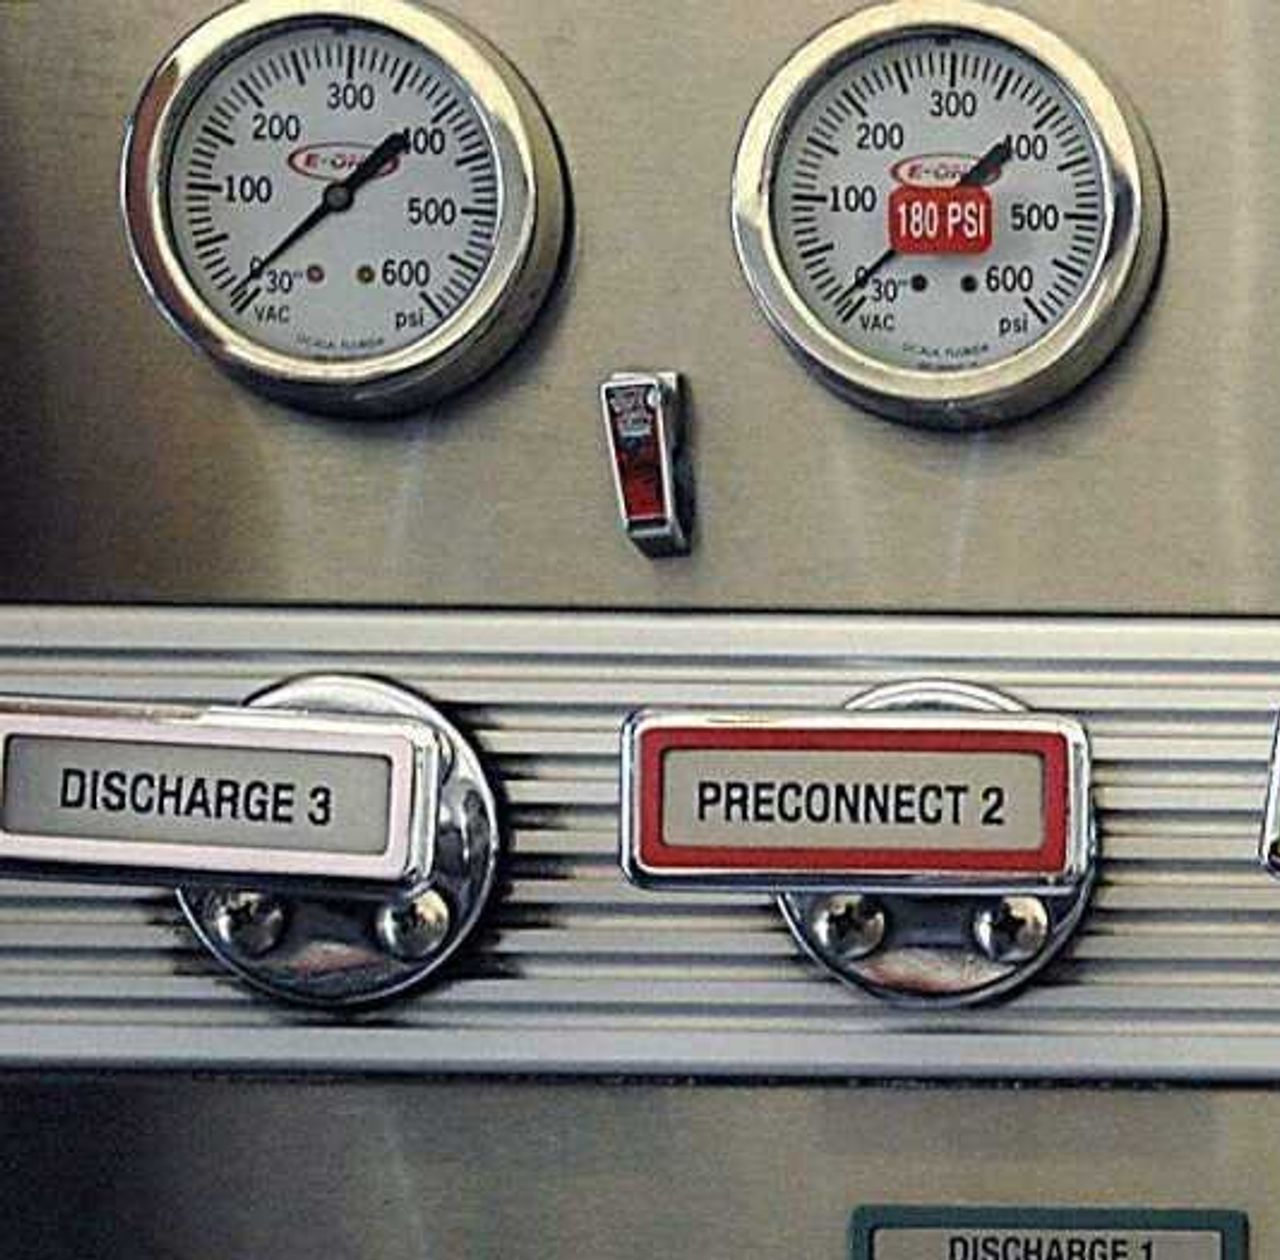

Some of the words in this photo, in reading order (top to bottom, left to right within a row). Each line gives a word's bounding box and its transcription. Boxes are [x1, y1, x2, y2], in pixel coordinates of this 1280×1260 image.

[328, 85, 374, 110] 300
[930, 91, 976, 117] 300
[253, 114, 300, 140] 200
[857, 124, 903, 149] 200
[304, 153, 365, 168] E-ON
[908, 163, 970, 179] E-ON
[226, 176, 272, 202] 100
[831, 186, 876, 212] 100
[408, 199, 456, 225] 500
[899, 202, 938, 237] 180
[949, 203, 984, 238] PSI
[1012, 205, 1058, 230] 500
[382, 260, 430, 286] 600
[986, 267, 1033, 292] 600
[254, 307, 290, 323] VAC
[396, 307, 424, 328] psi
[859, 314, 895, 330] VAC
[1000, 314, 1028, 335] psi
[61, 768, 294, 824] DISCHARGE
[307, 786, 331, 826] 3
[698, 782, 968, 824] PRECONNECT
[982, 787, 1004, 825] 2
